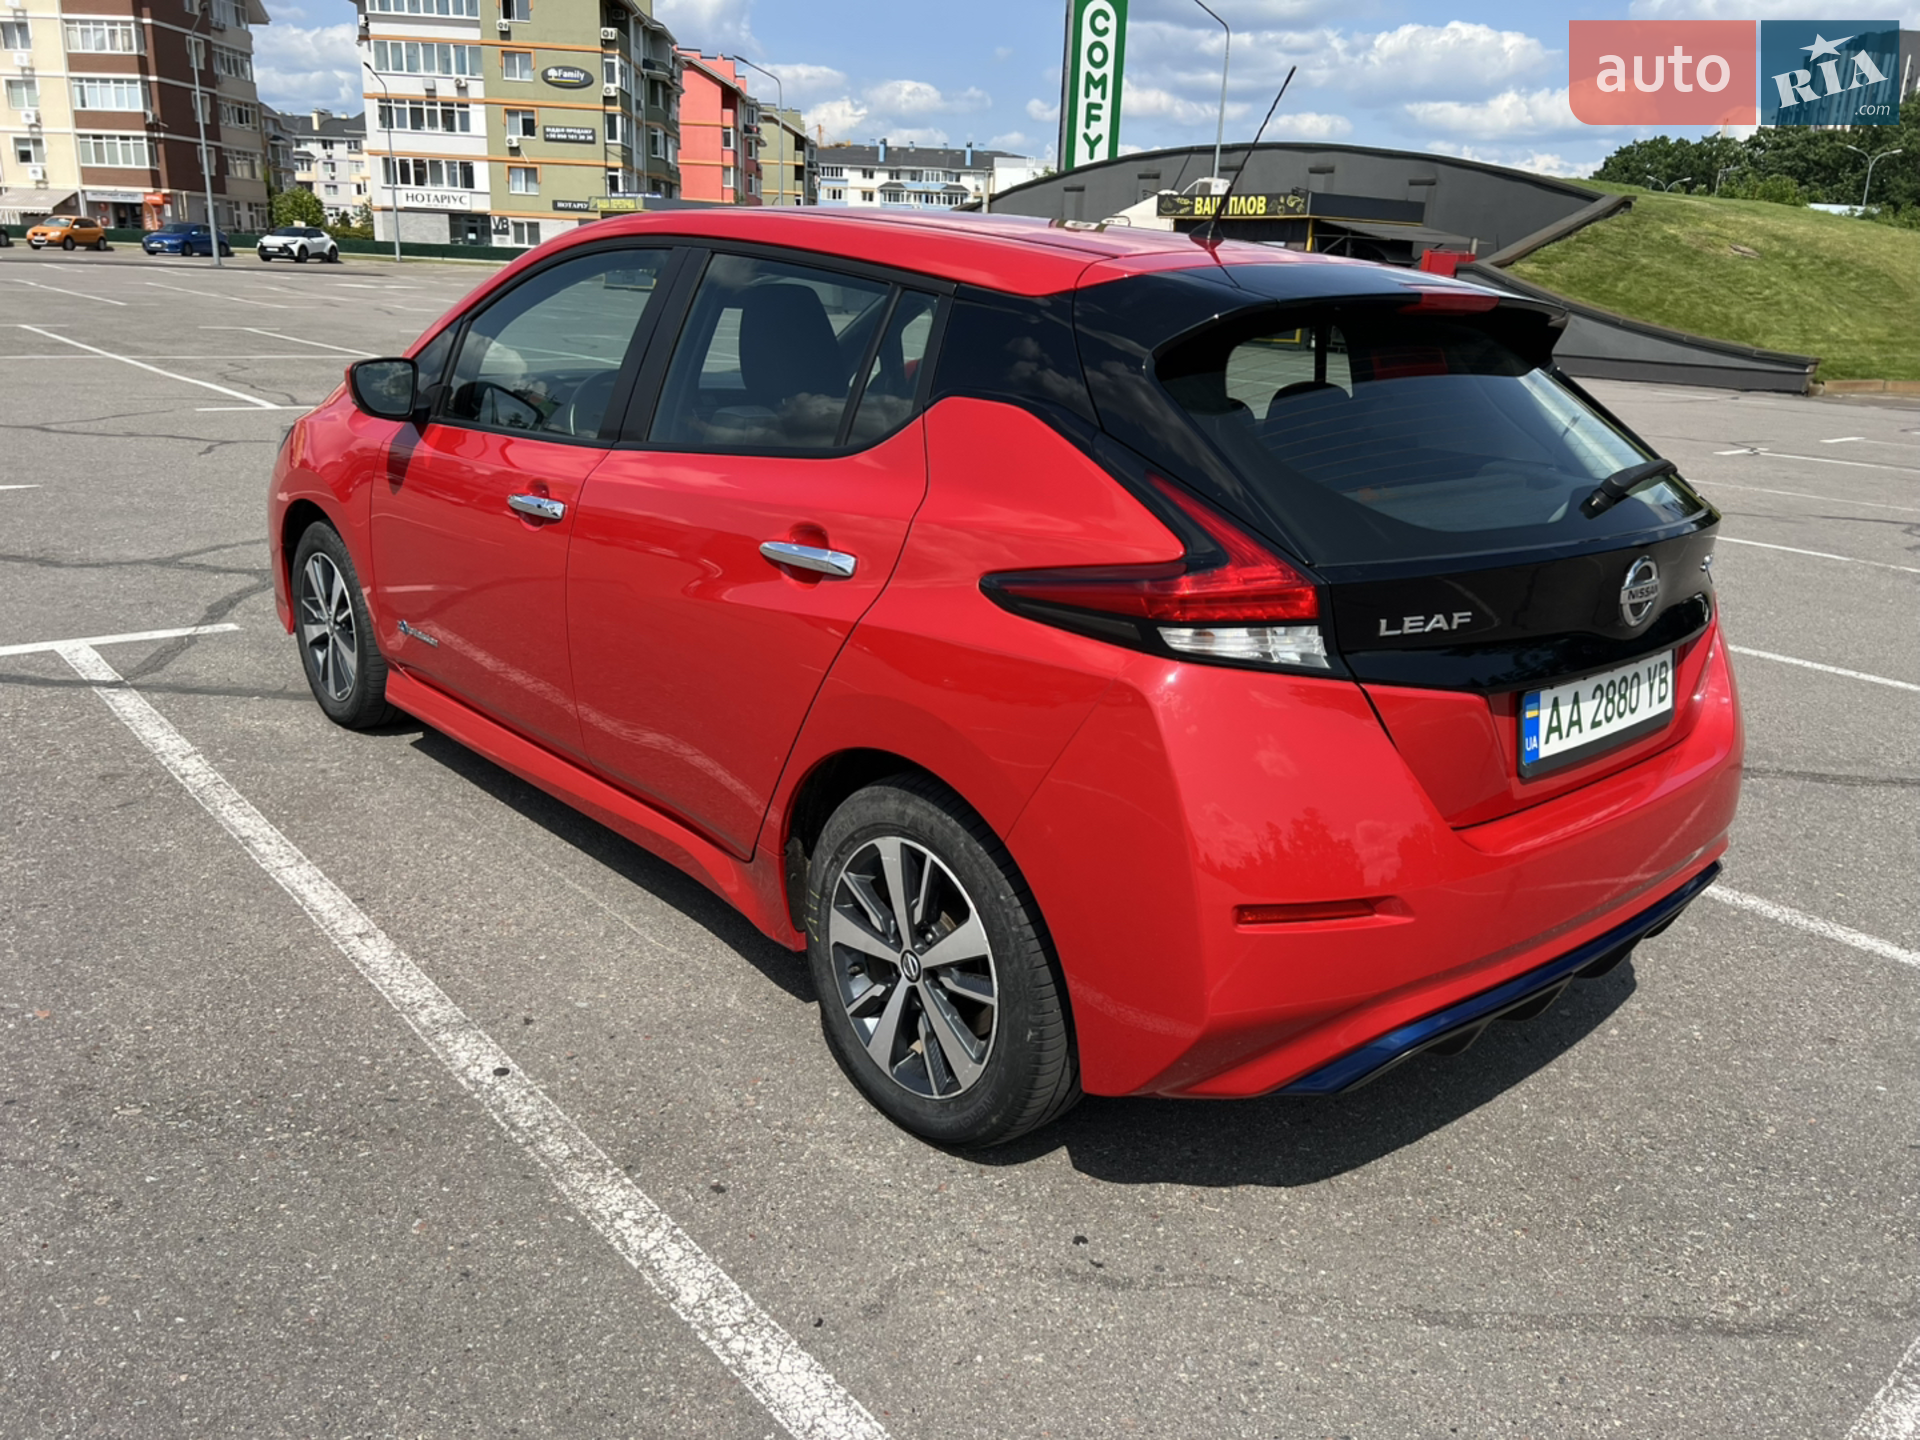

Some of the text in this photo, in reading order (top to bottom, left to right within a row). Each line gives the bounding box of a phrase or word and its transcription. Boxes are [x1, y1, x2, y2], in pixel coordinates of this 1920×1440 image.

[558, 69, 585, 81] Family
[1082, 8, 1111, 161] COMFY
[405, 192, 468, 206] НОТАРІУС
[556, 201, 589, 209] НОТАРІУ
[1228, 195, 1267, 215] ПЛОВ
[1627, 585, 1659, 600] NISSAN
[1379, 611, 1473, 637] LEAF
[1544, 660, 1669, 745] AA 2880 YB
[1525, 736, 1538, 752] UA
